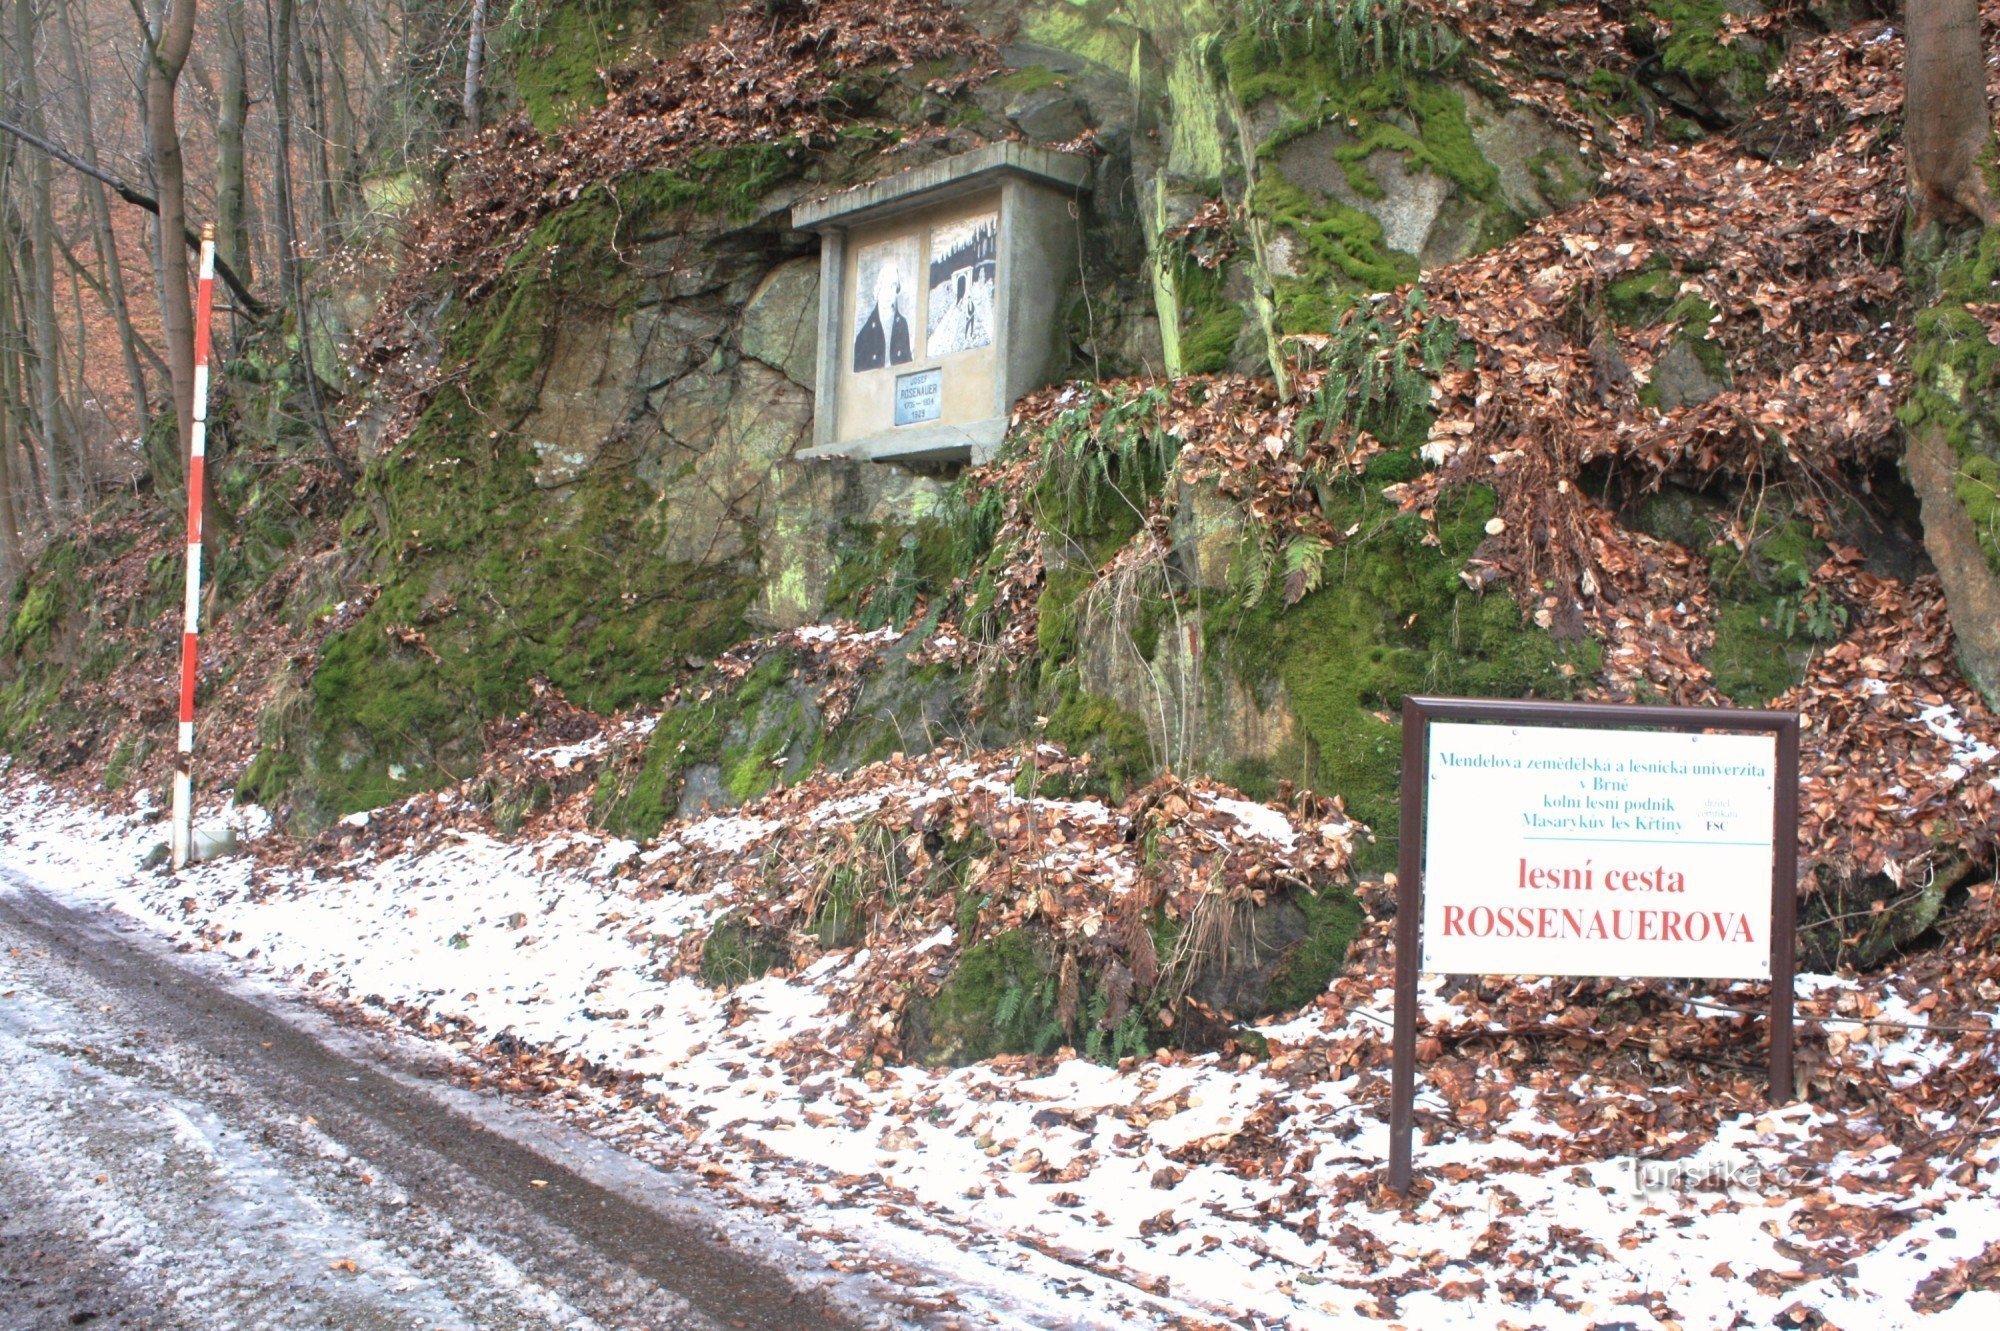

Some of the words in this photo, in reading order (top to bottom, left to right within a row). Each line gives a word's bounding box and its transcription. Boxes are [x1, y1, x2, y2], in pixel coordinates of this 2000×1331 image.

[1439, 751, 1521, 769] Mendelova
[1526, 756, 1612, 773] zemědělská
[1615, 762, 1625, 773] a
[1628, 759, 1688, 775] lesnická
[1692, 762, 1766, 778] univerzita
[1579, 780, 1587, 790] v
[1593, 777, 1629, 792] Brně
[1585, 795, 1619, 810] lesní
[1623, 797, 1675, 816] podnik
[1521, 812, 1606, 832] Masarykův
[1610, 815, 1630, 830] les
[1635, 816, 1683, 835] Křtiny
[1706, 820, 1729, 832] FSC
[1518, 858, 1592, 891] lesní
[1604, 864, 1686, 893] cesta
[1442, 905, 1755, 944] ROSSENAUEROVA
